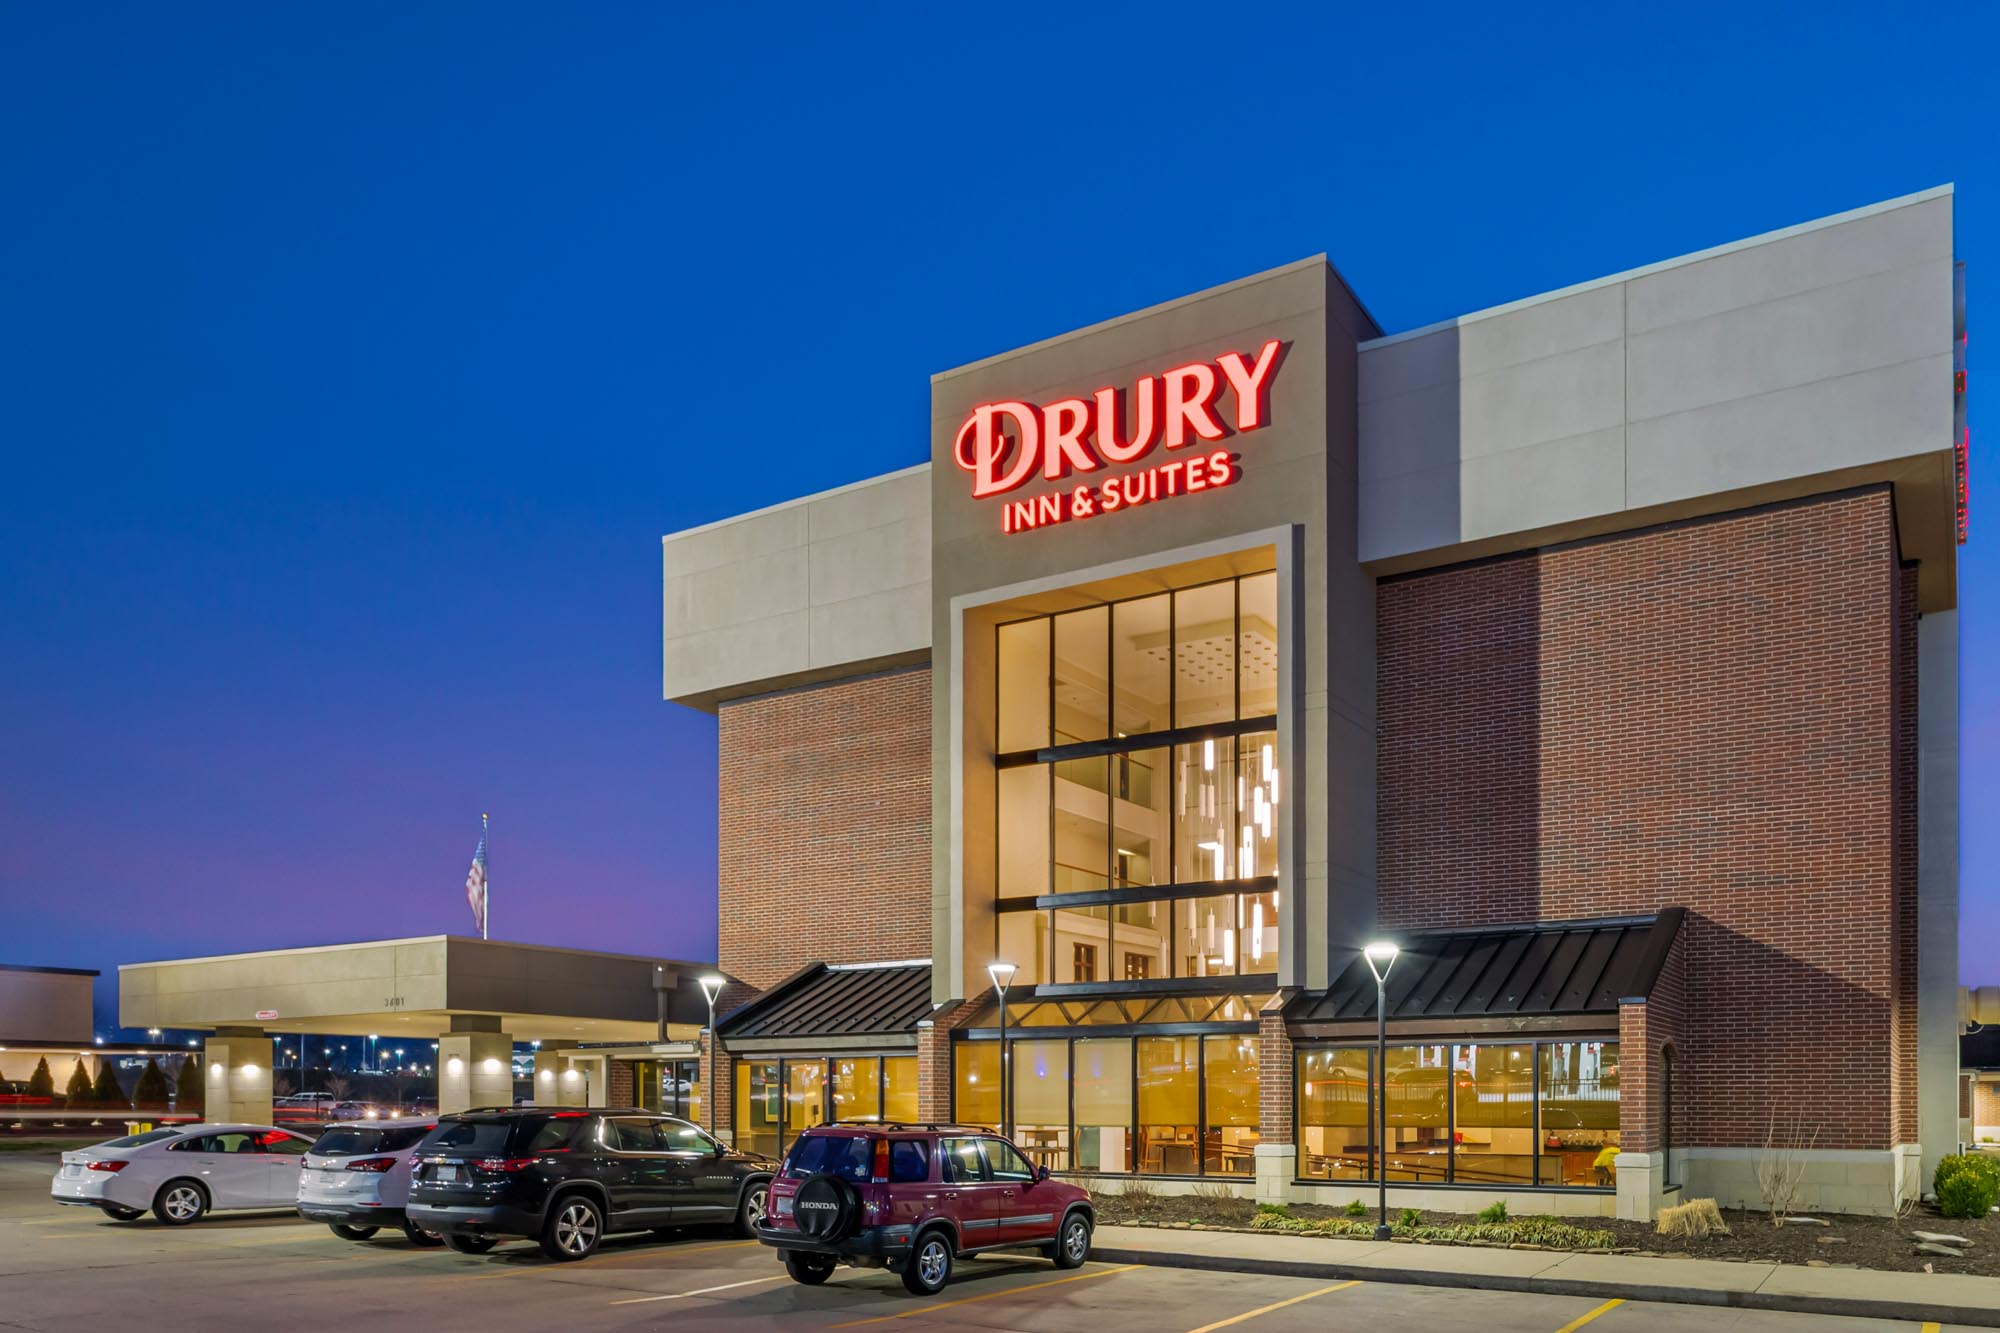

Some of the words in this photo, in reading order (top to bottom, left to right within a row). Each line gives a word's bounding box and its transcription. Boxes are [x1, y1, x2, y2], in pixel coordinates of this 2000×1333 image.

[954, 339, 1282, 498] DRURY
[1003, 491, 1062, 534] INN
[1071, 485, 1094, 518] &
[1101, 450, 1234, 511] SUITES
[800, 1201, 838, 1210] HONDA
